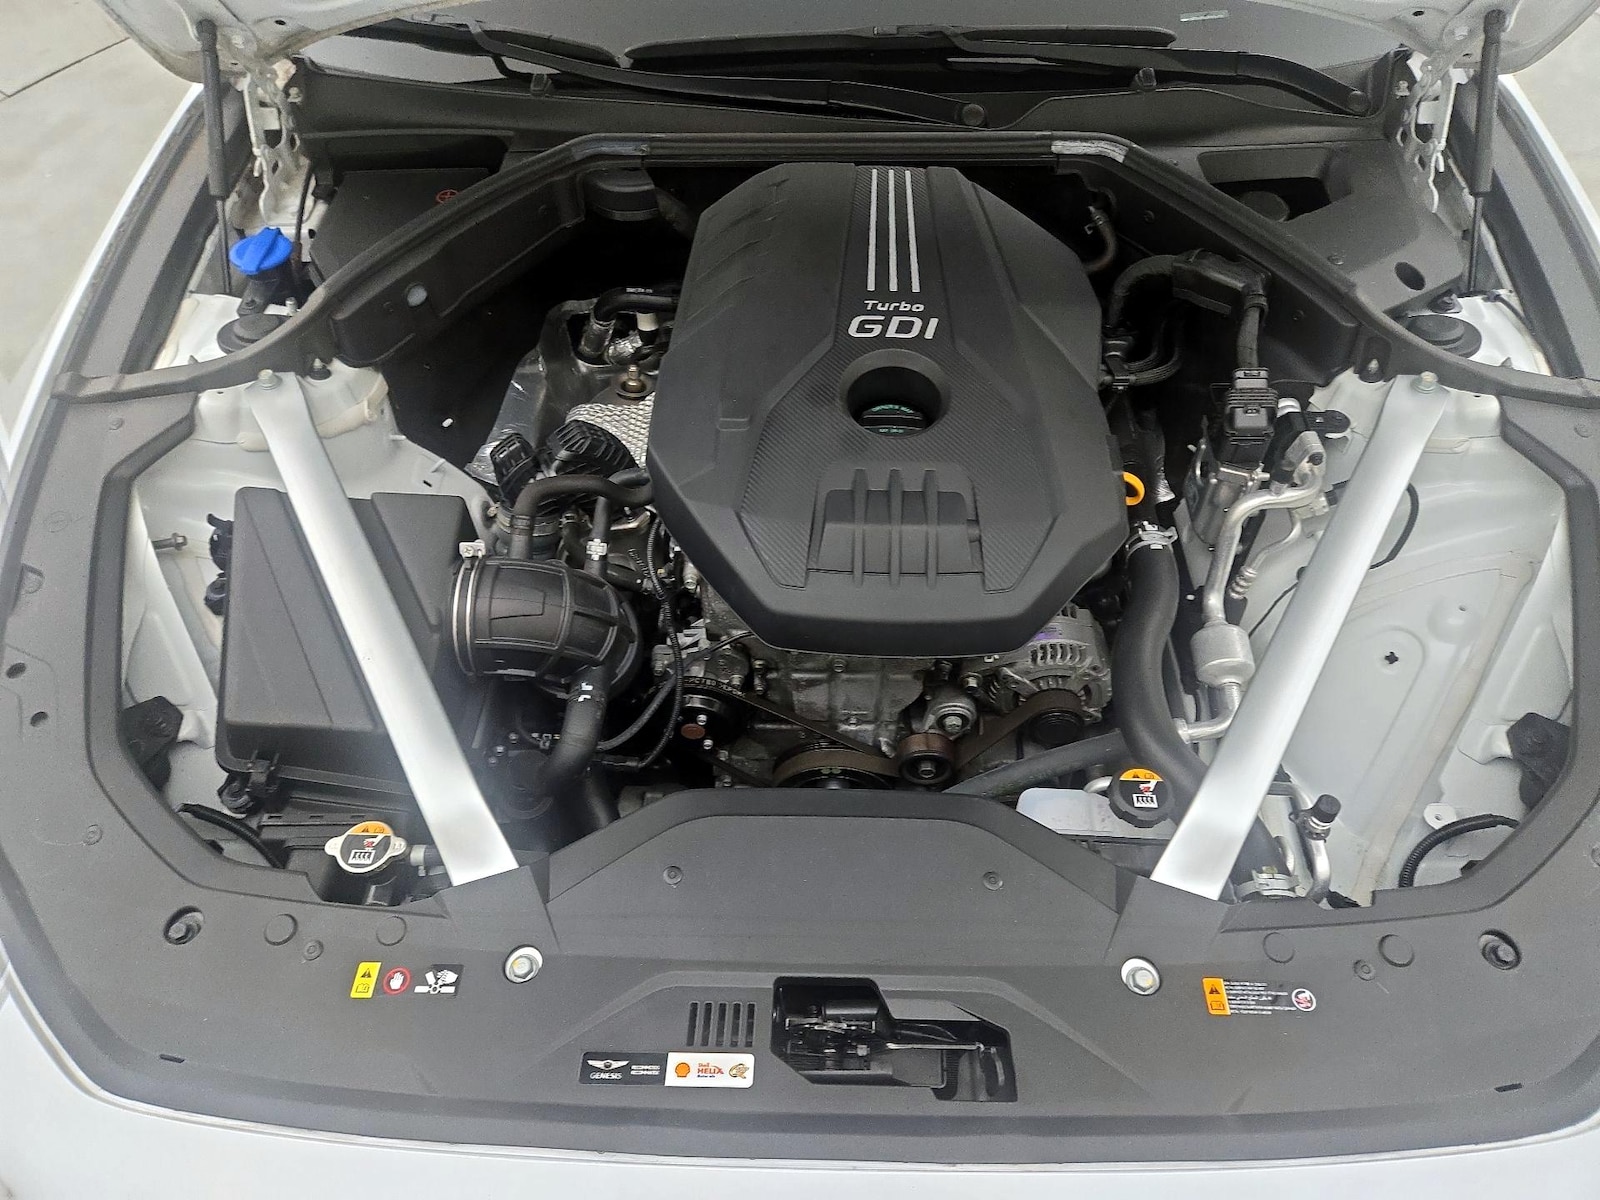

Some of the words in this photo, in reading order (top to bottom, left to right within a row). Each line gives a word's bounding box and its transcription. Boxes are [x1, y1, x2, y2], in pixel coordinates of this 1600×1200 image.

[864, 300, 925, 312] Turbo
[848, 315, 939, 340] GDI
[697, 1066, 725, 1074] HELIX
[589, 1072, 623, 1080] GENESIS
